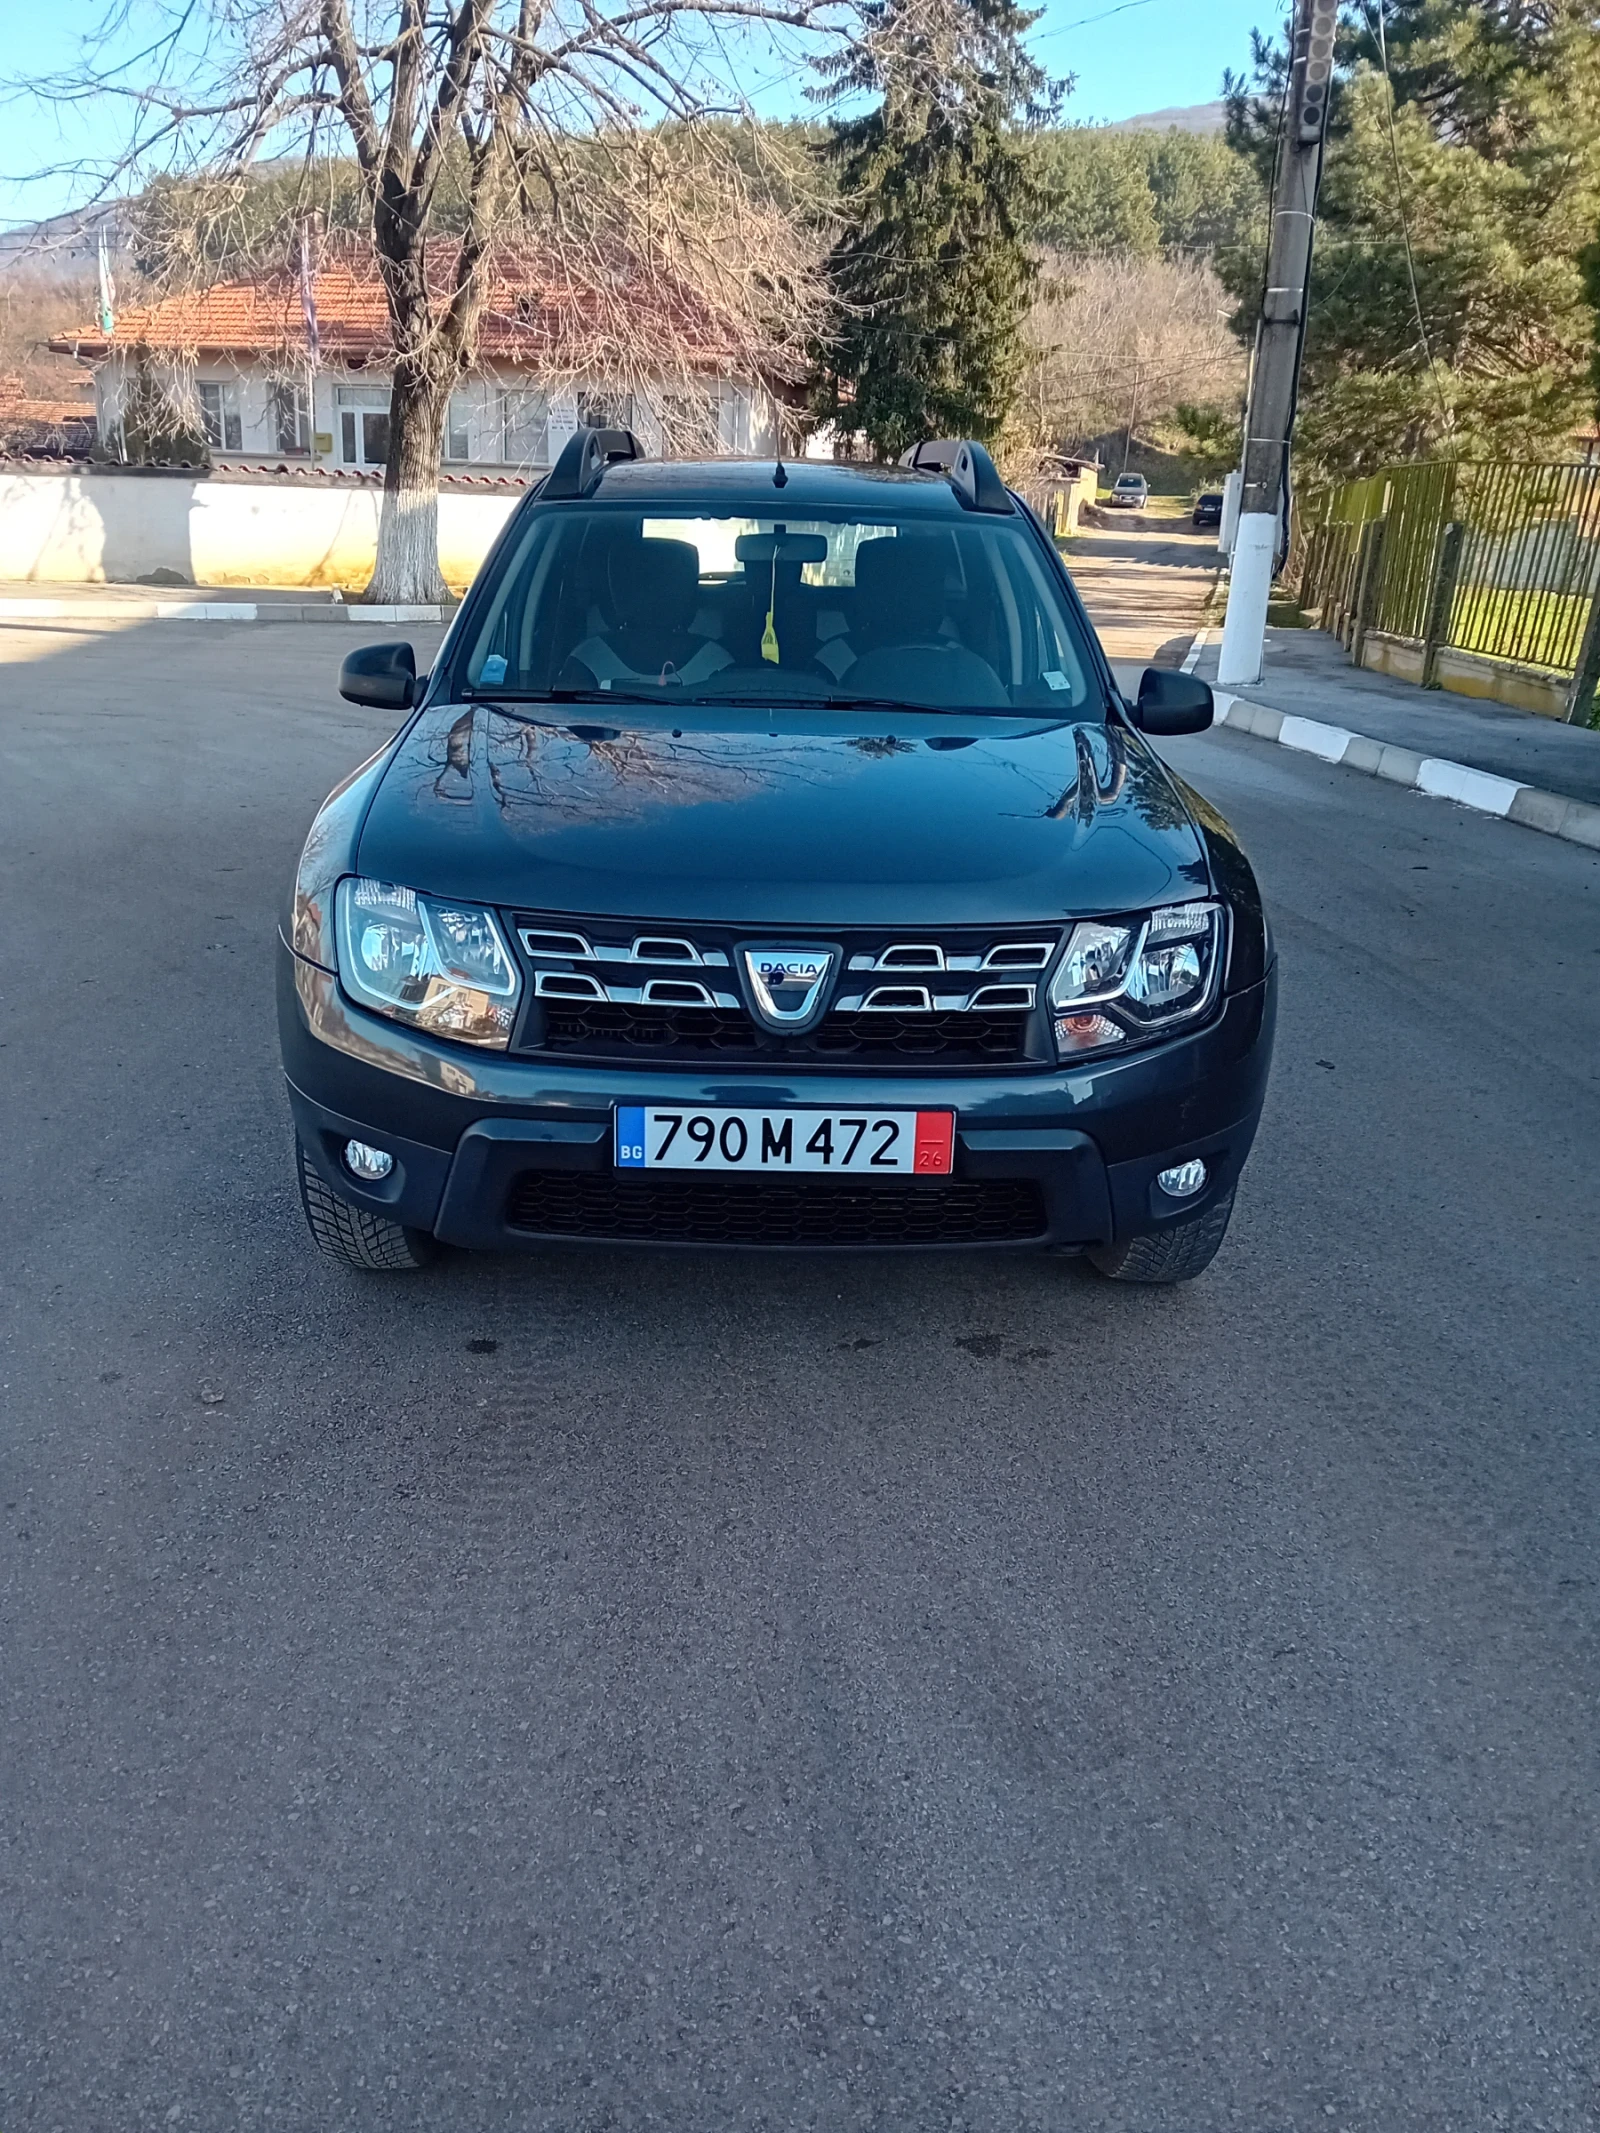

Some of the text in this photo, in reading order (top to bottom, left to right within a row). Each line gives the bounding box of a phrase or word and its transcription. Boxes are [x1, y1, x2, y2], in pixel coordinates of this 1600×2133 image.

[760, 962, 817, 974] DACIA
[653, 1114, 900, 1166] 790 M 472
[621, 1145, 643, 1159] BG
[919, 1150, 943, 1167] 26
